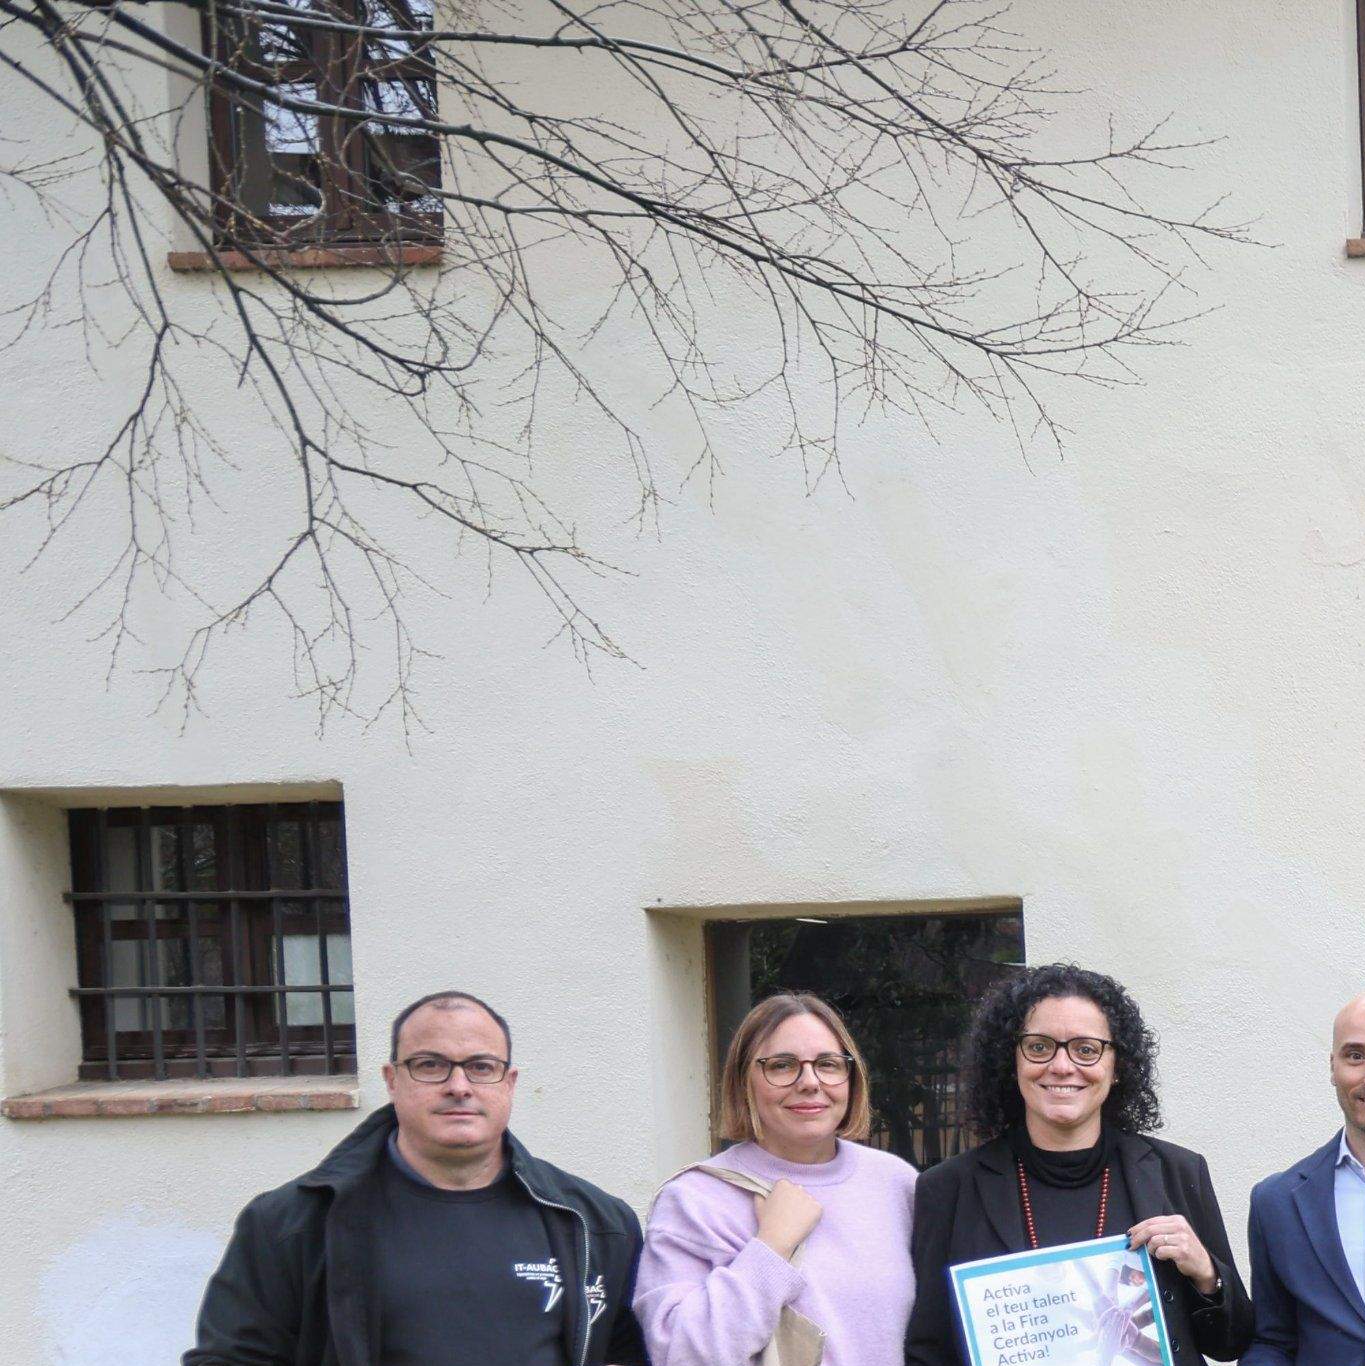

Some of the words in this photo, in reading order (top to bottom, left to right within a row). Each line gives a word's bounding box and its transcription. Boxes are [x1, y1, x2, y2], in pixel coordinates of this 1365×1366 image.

[983, 1283, 1031, 1301] Activa
[986, 1302, 1001, 1317] el
[1004, 1300, 1029, 1314] teu
[1033, 1290, 1077, 1309] talent
[990, 1325, 999, 1334] a
[1003, 1319, 1016, 1332] la
[1020, 1313, 1049, 1328] Fira
[993, 1325, 1079, 1350] Cerdanyola
[998, 1347, 1050, 1366] Activa!
